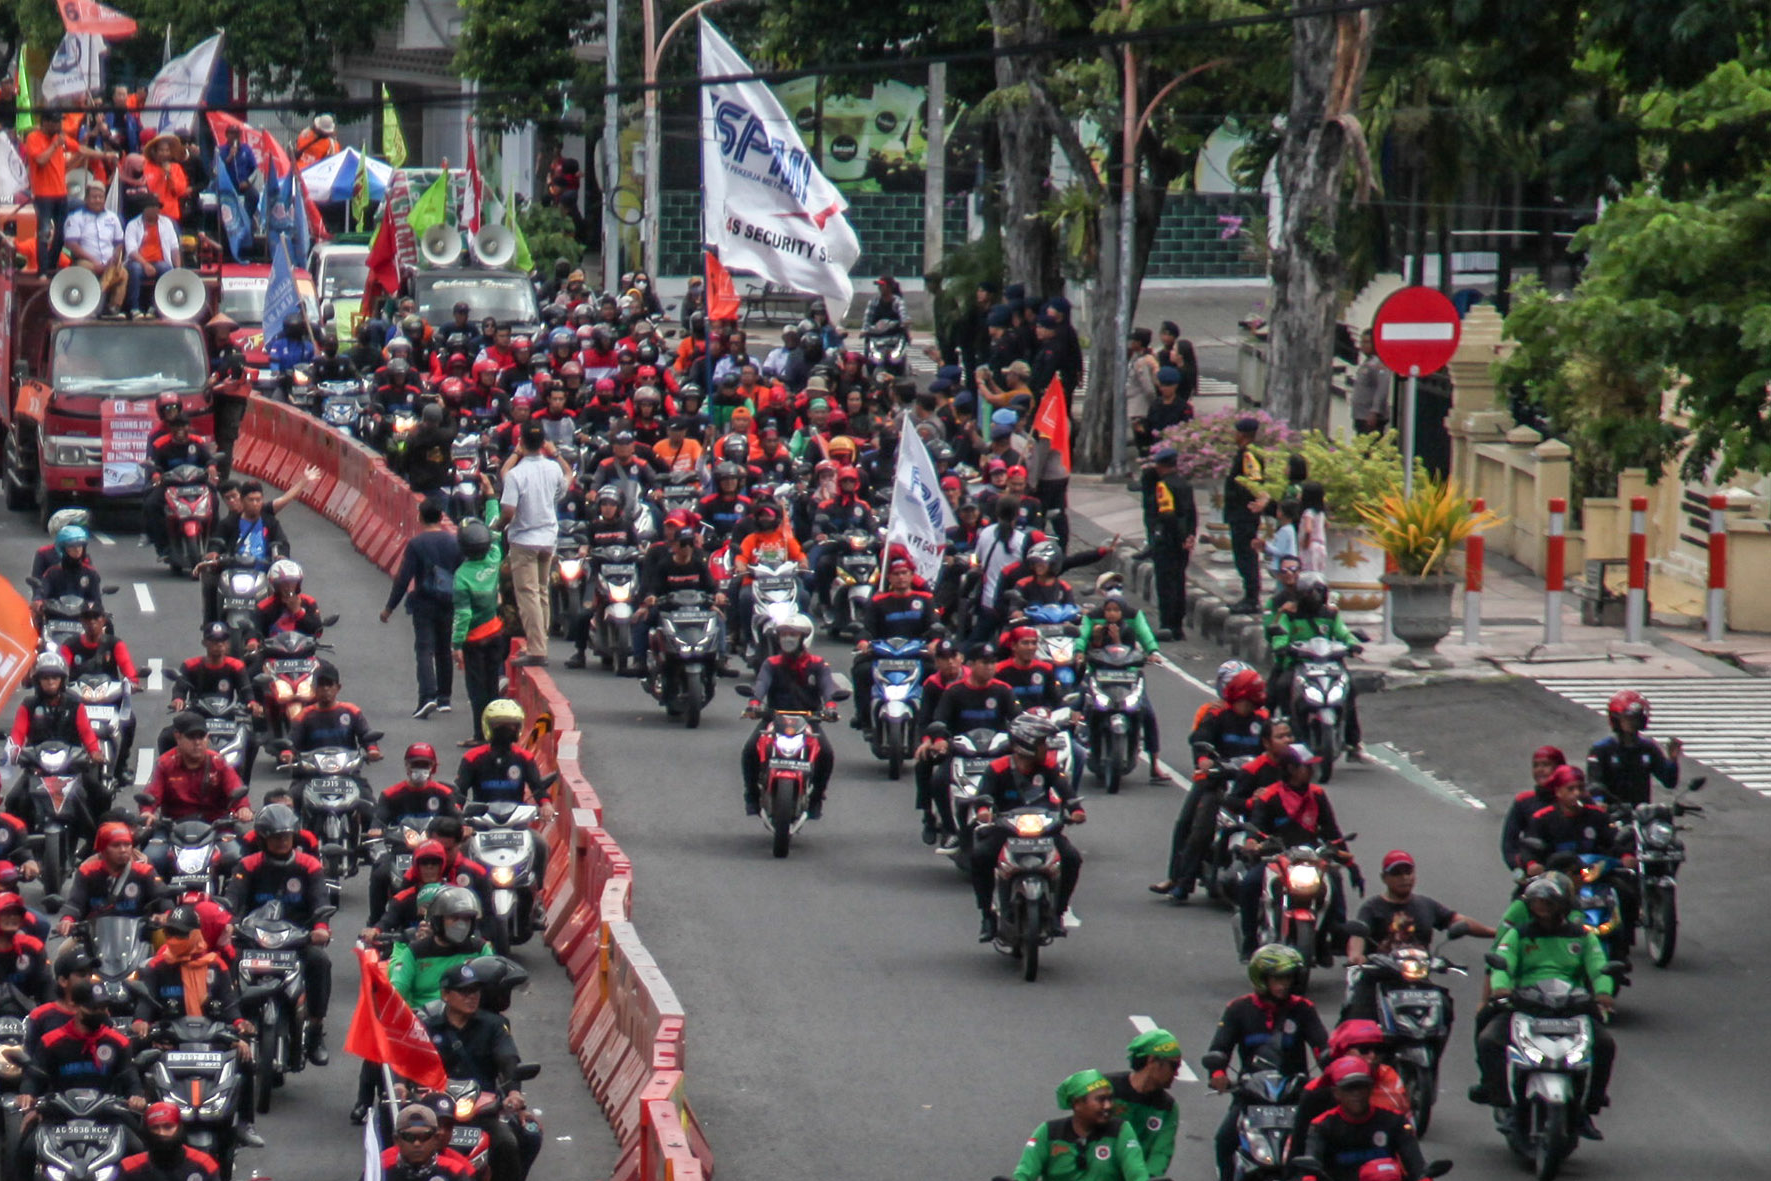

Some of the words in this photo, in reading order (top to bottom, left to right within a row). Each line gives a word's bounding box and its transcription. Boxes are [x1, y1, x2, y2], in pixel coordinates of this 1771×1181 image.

[744, 223, 816, 260] SECURITY
[55, 1126, 67, 1134] AG
[69, 1126, 89, 1134] 5636
